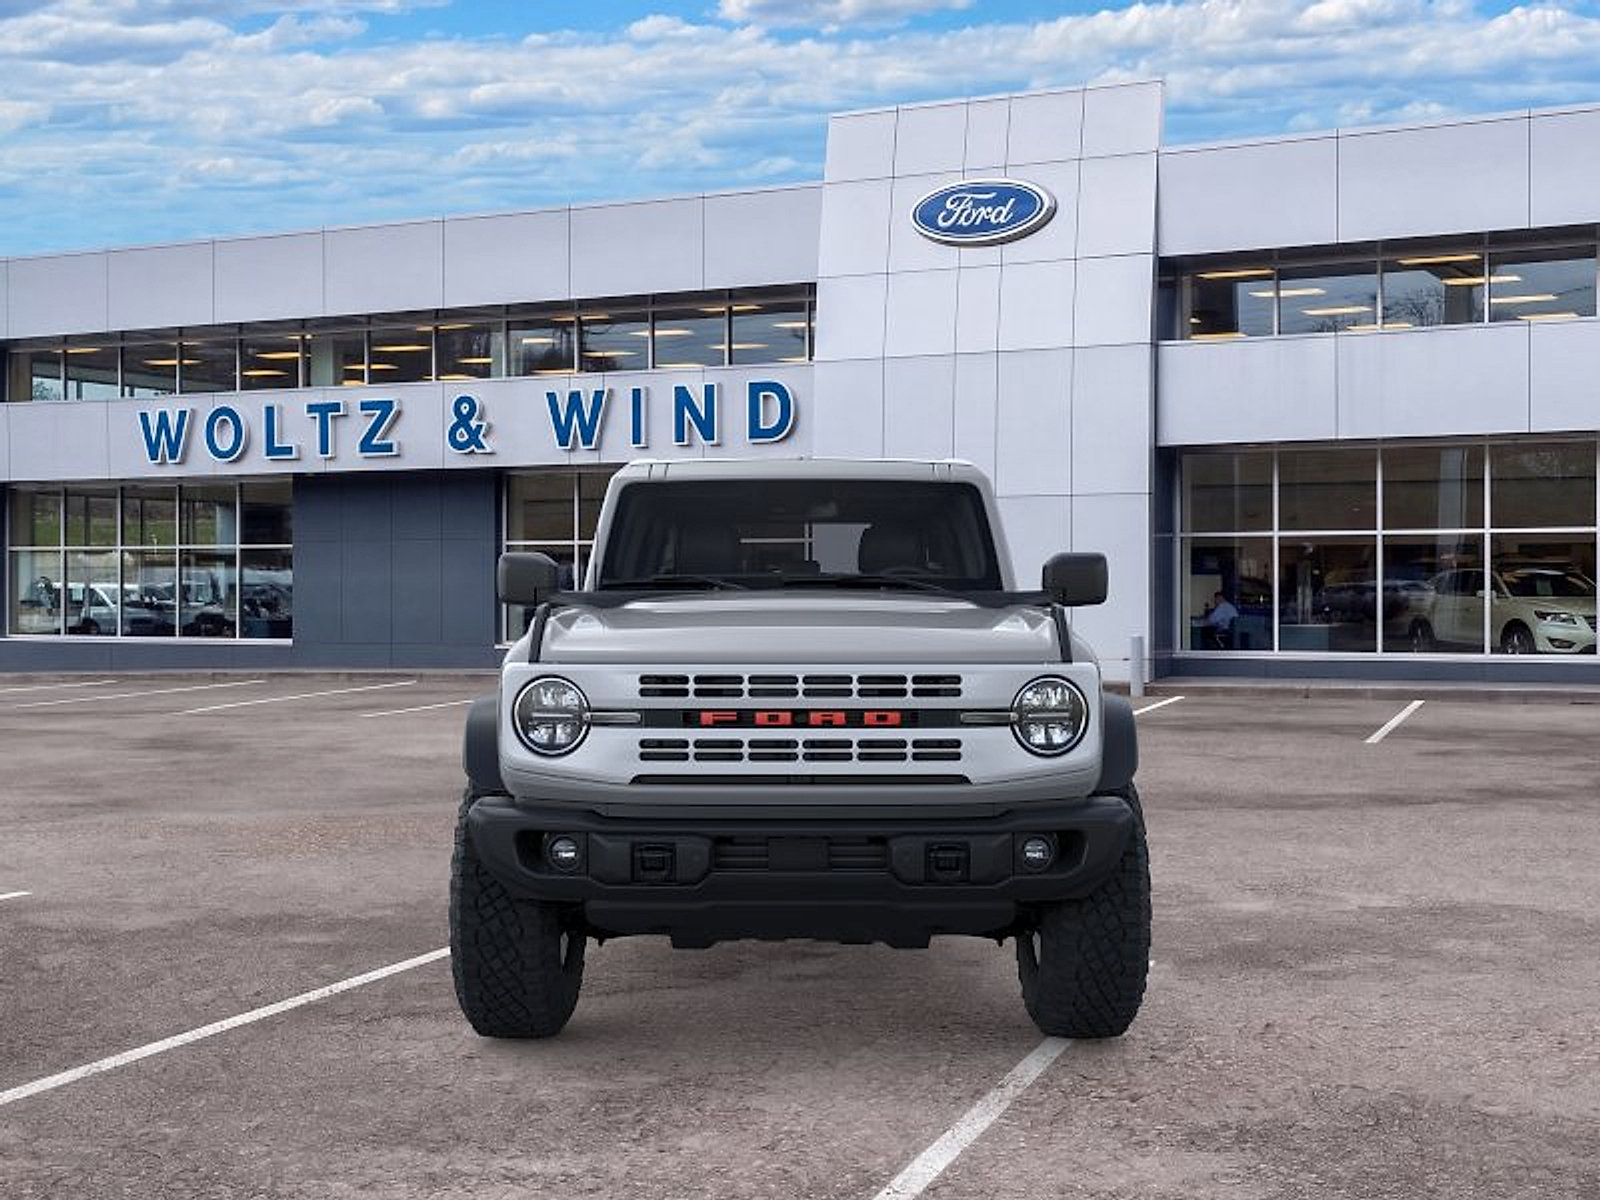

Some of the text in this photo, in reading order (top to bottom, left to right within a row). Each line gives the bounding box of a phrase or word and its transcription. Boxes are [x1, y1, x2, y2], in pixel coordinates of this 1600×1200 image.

[938, 192, 1015, 227] Ford
[139, 380, 796, 464] WOLTZ & WIND
[700, 711, 902, 726] FORD
